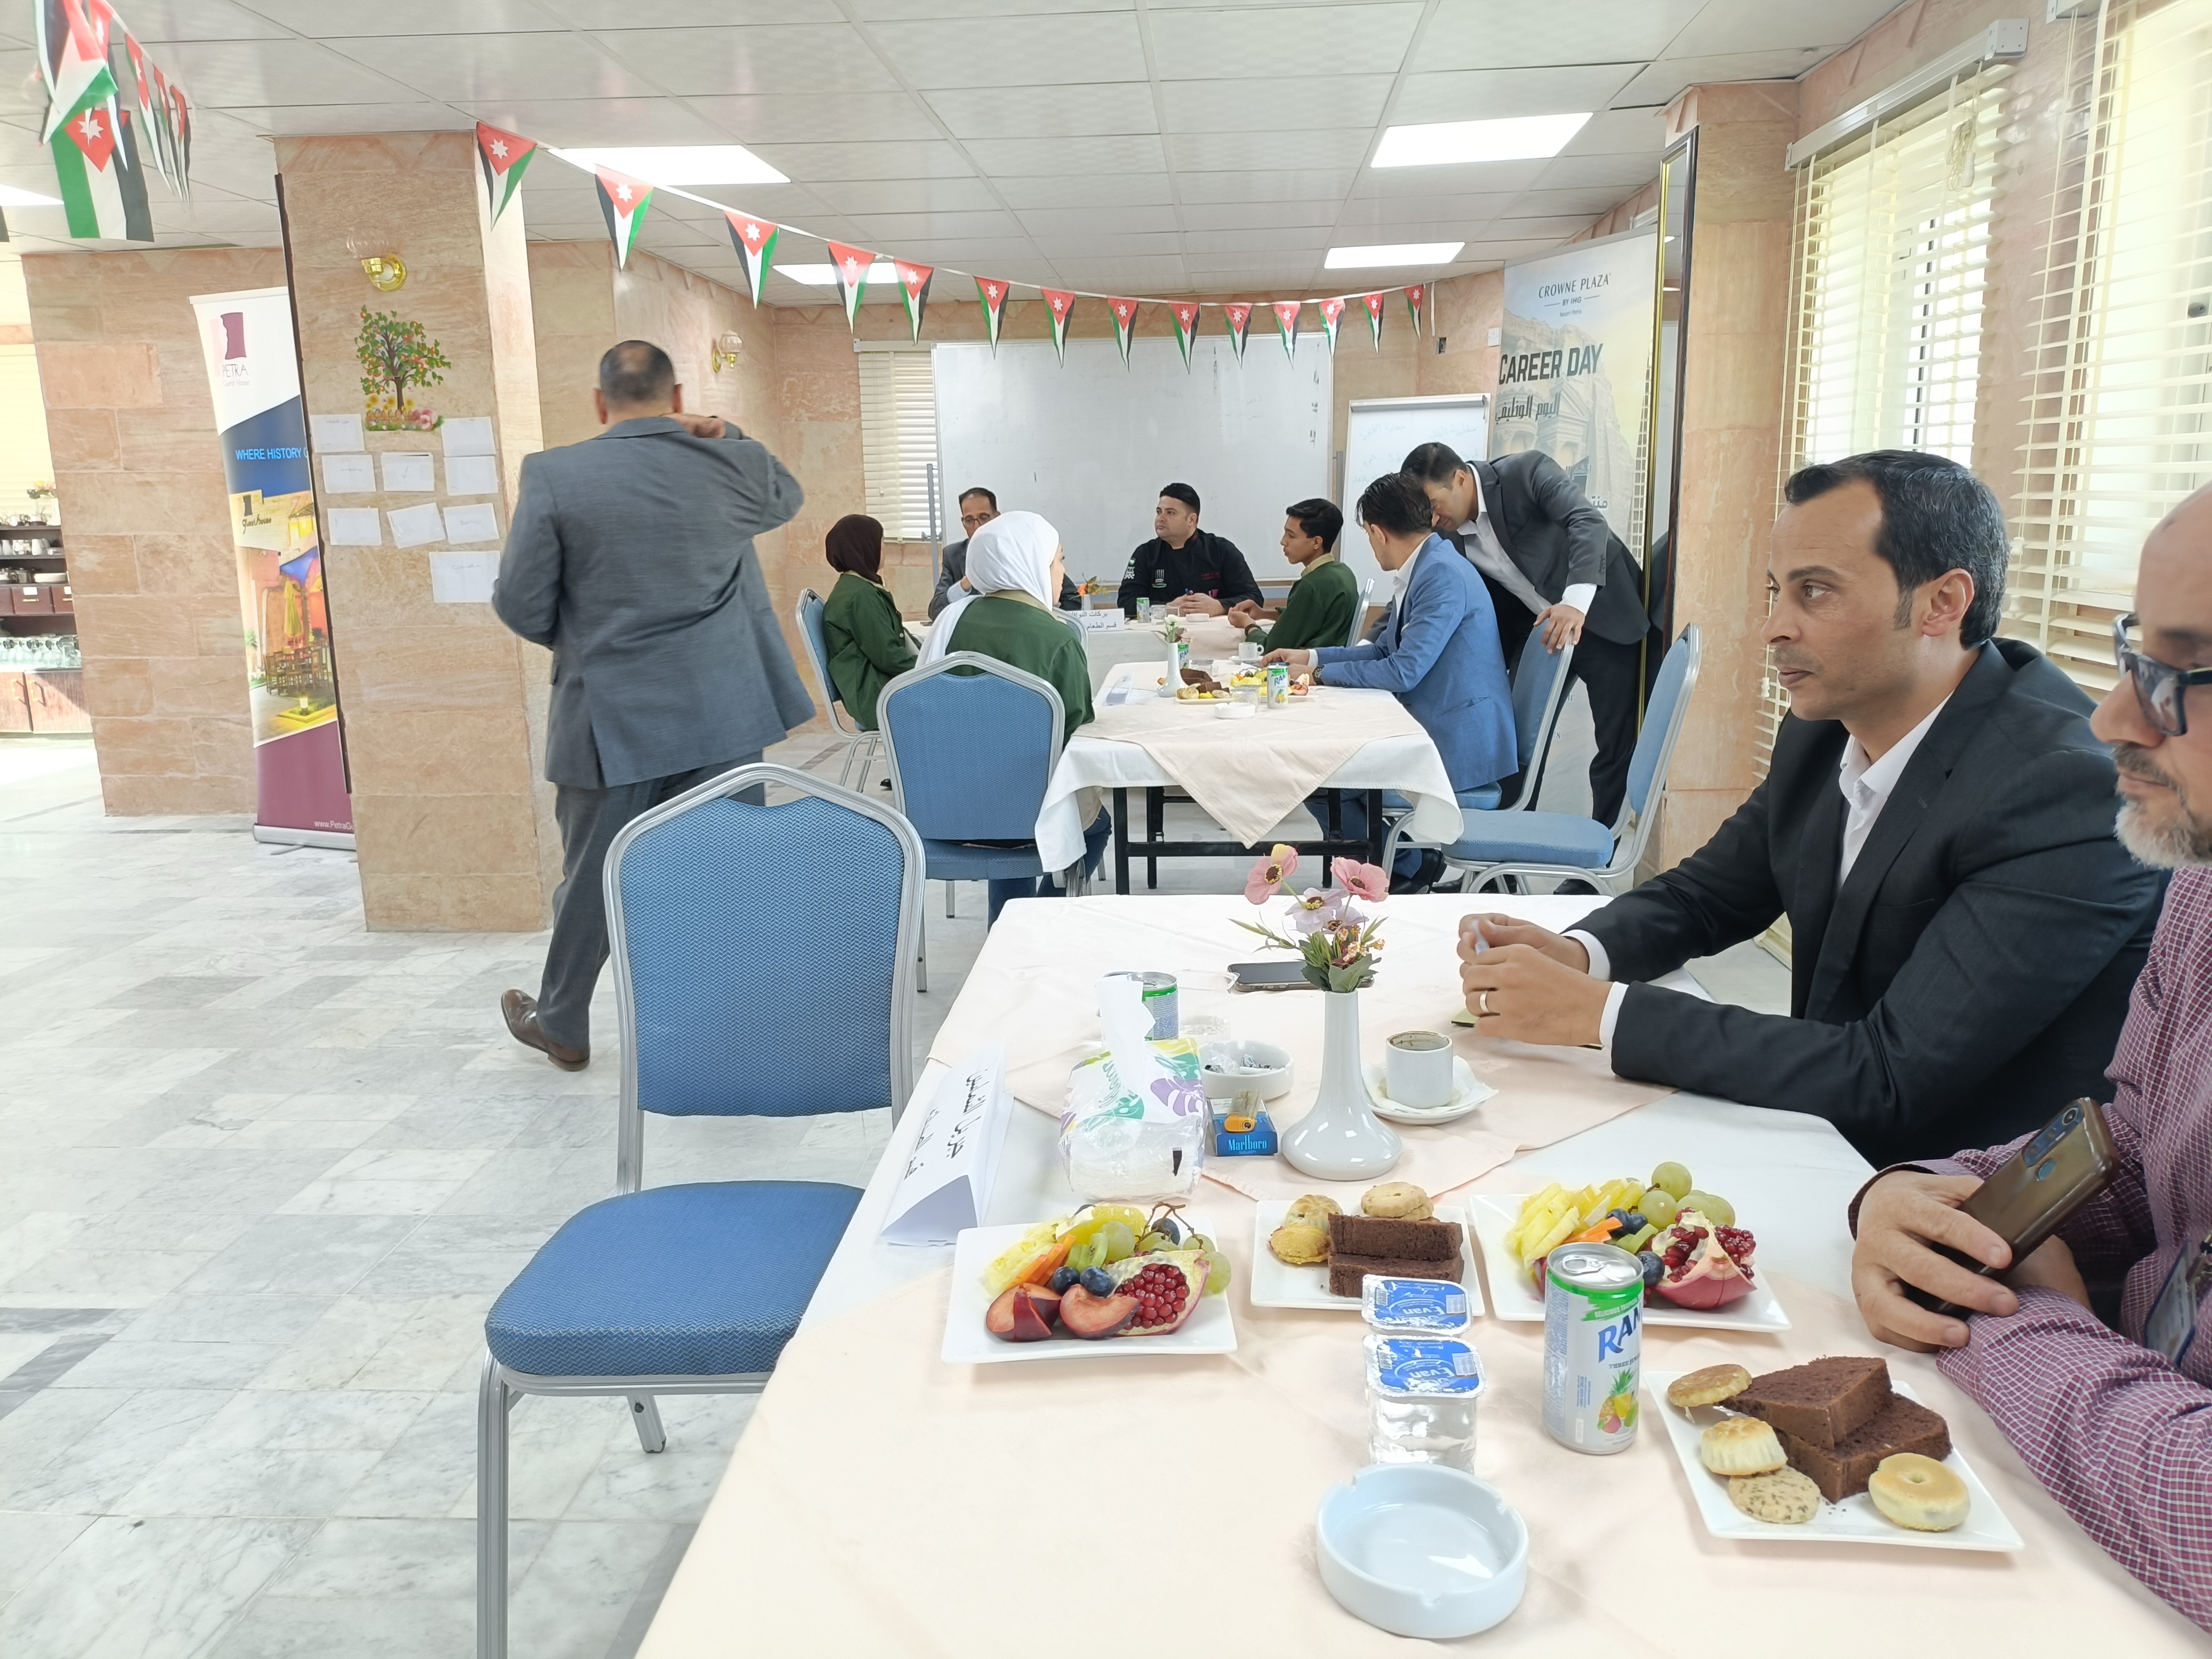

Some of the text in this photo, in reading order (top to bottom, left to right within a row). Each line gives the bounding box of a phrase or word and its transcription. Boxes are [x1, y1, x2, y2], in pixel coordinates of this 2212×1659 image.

[1538, 274, 1609, 299] CROWNE PLAZA
[1562, 298, 1570, 306] BY
[1498, 343, 1604, 385] CAREER DAY
[221, 364, 249, 378] PETRA
[1535, 391, 1561, 422] اليوم
[235, 448, 266, 461] WHERE
[266, 447, 302, 459] HISTORY
[1592, 496, 1608, 509] منت
[1086, 622, 1117, 630] قسم الطعام
[314, 820, 355, 830] www.PetraGu
[1228, 1135, 1267, 1151] Marlboro
[1402, 1305, 1446, 1316] Evan
[1594, 1306, 1620, 1318] DELICIOUS
[1608, 1360, 1629, 1369] THREE
[1408, 1366, 1456, 1379] Evan
